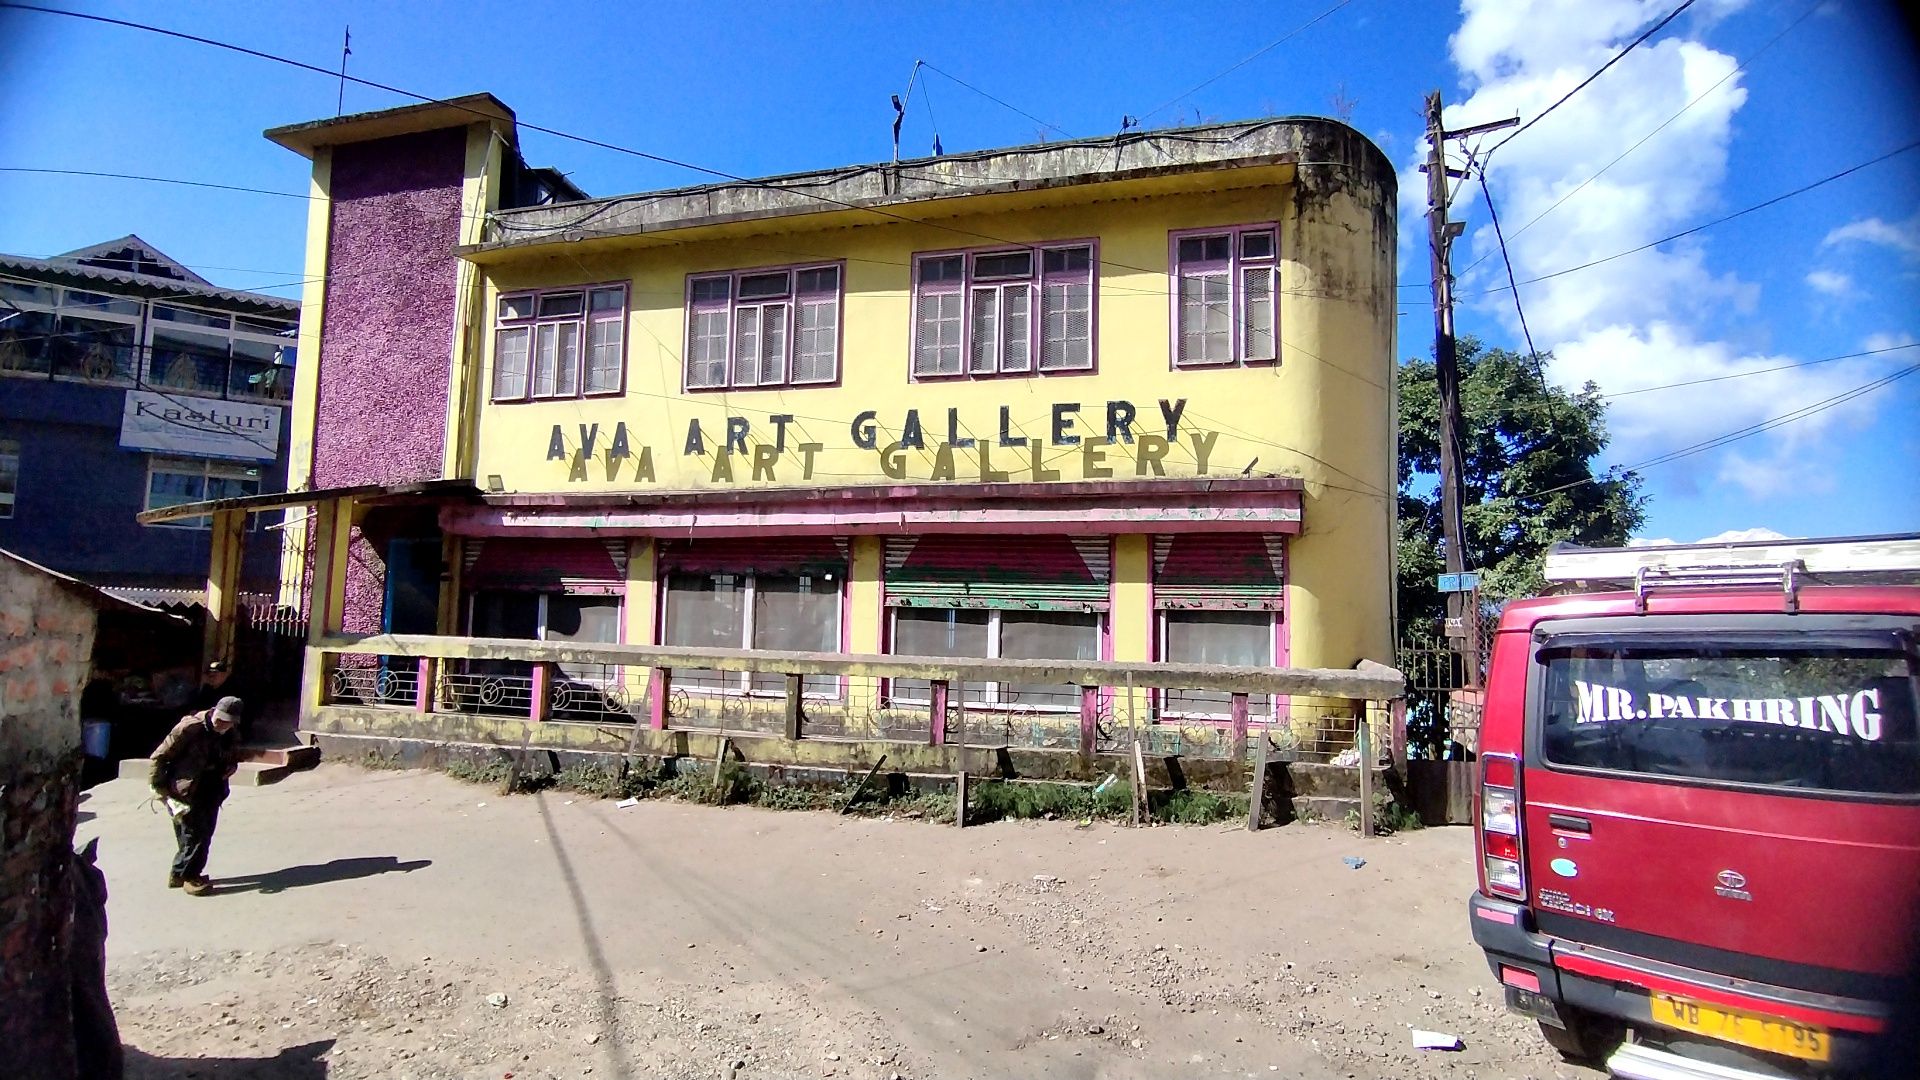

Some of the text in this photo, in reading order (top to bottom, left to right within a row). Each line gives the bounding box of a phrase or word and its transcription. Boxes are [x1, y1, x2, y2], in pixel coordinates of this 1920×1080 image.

[135, 400, 272, 431] Kasturi
[546, 398, 1188, 461] AVA ART GALLERY
[1665, 996, 1700, 1026] WB
